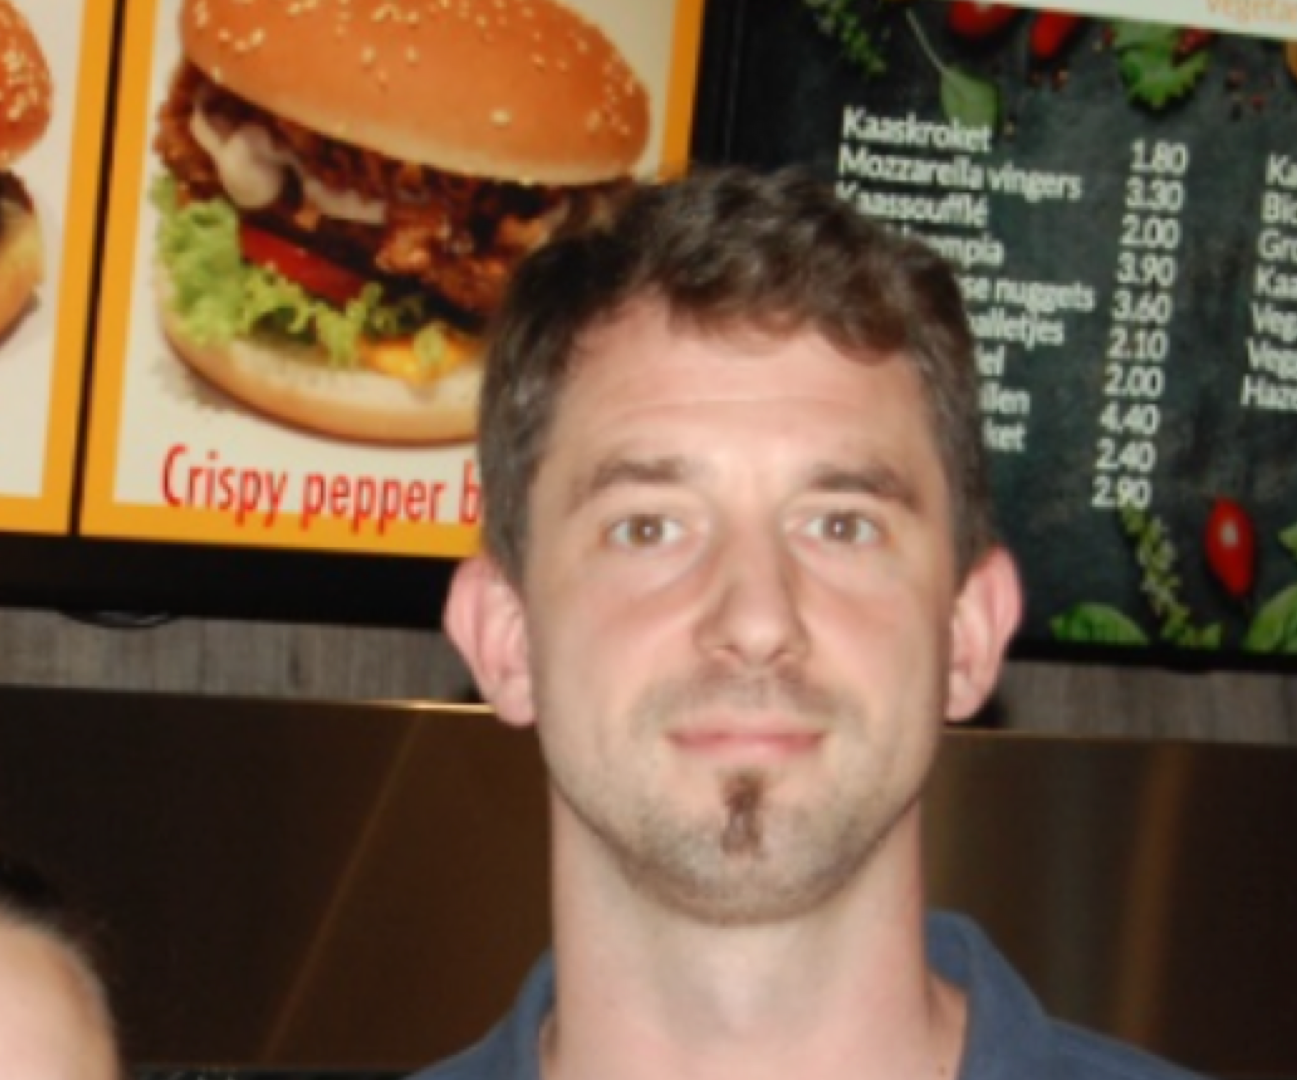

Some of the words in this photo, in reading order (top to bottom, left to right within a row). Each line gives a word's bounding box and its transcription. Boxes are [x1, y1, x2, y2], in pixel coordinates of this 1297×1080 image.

[842, 106, 992, 153] Kaaskroket
[837, 143, 983, 192] Mozzarella
[987, 163, 1083, 203] vingers
[1131, 139, 1188, 175] 1.80
[1125, 176, 1184, 212] 3.30
[1119, 213, 1179, 249] 2.00
[1115, 251, 1176, 287] 3.90
[956, 274, 989, 301] se
[995, 276, 1096, 314] nuggets
[1110, 288, 1172, 324] 3.60
[967, 306, 1065, 351] alletjes
[1108, 326, 1168, 362] 2.10
[1105, 362, 1165, 397] 2.00
[982, 417, 1026, 452] ket
[1098, 400, 1161, 435] 4.40
[1095, 437, 1156, 473] 2.40
[161, 442, 289, 529] Crispy
[300, 472, 447, 537] pepper
[458, 459, 481, 526] b
[1092, 474, 1152, 509] 2.90
